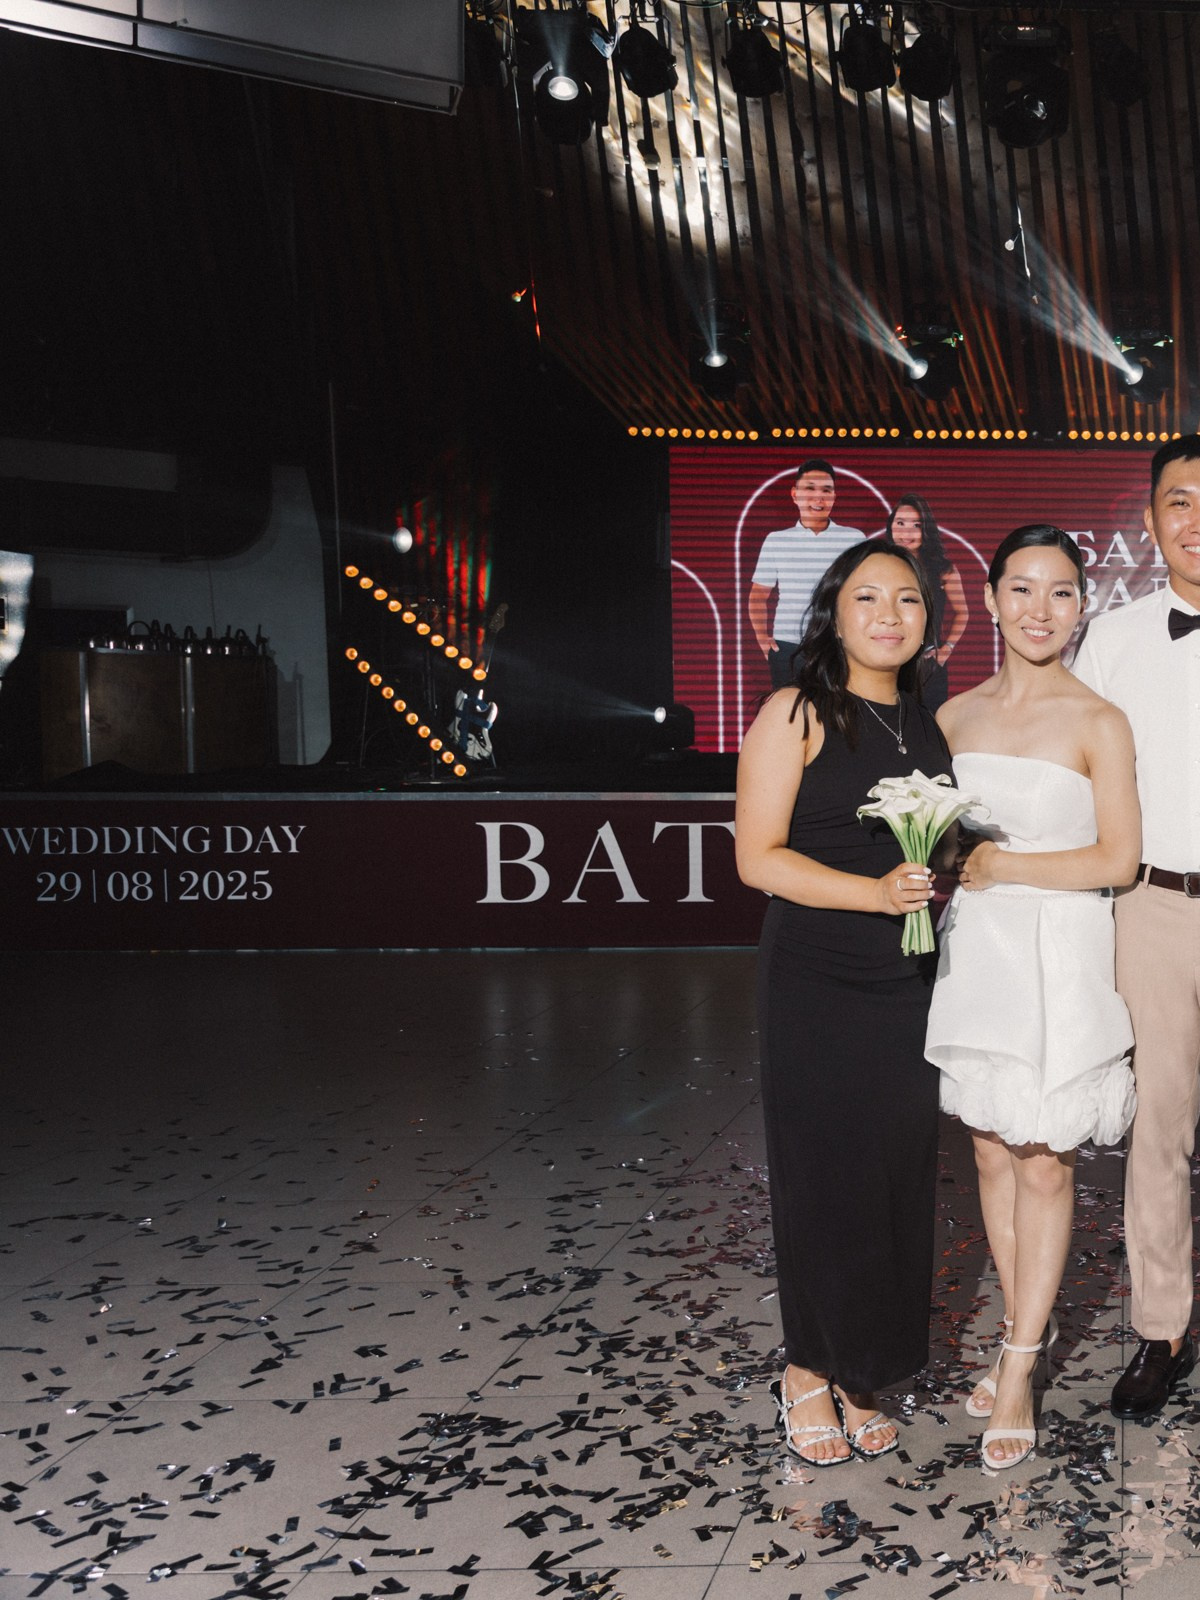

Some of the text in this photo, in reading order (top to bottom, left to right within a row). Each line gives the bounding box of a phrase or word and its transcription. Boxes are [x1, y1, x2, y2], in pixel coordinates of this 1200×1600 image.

[1, 825, 306, 854] WEDDING DAY
[475, 820, 772, 903] BAT
